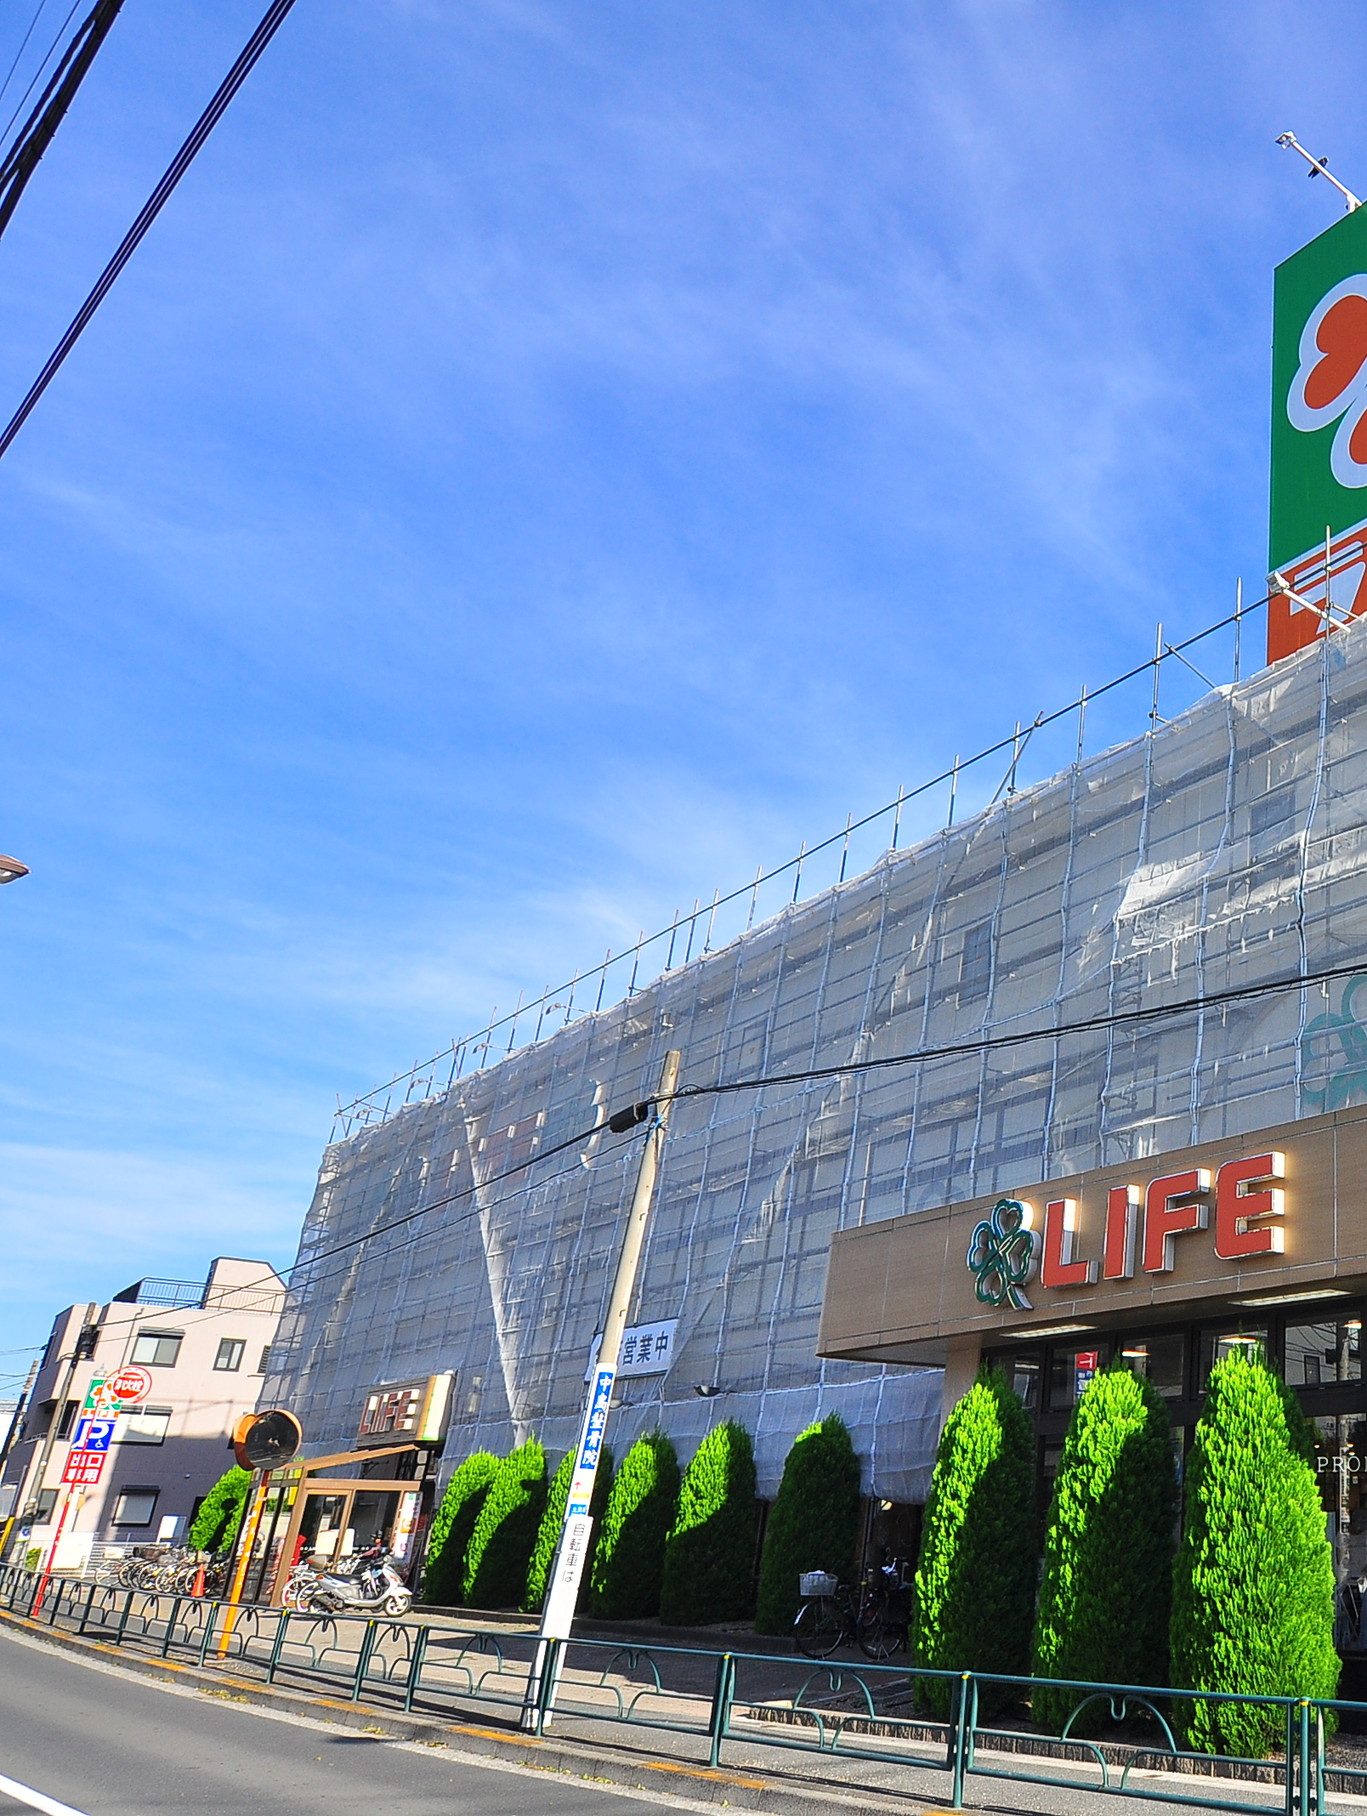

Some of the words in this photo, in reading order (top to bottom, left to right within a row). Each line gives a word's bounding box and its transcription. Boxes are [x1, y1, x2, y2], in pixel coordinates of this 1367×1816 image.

[1041, 1151, 1286, 1289] LIFE
[114, 1378, 144, 1392] 消火栓
[359, 1389, 420, 1435] LIFE
